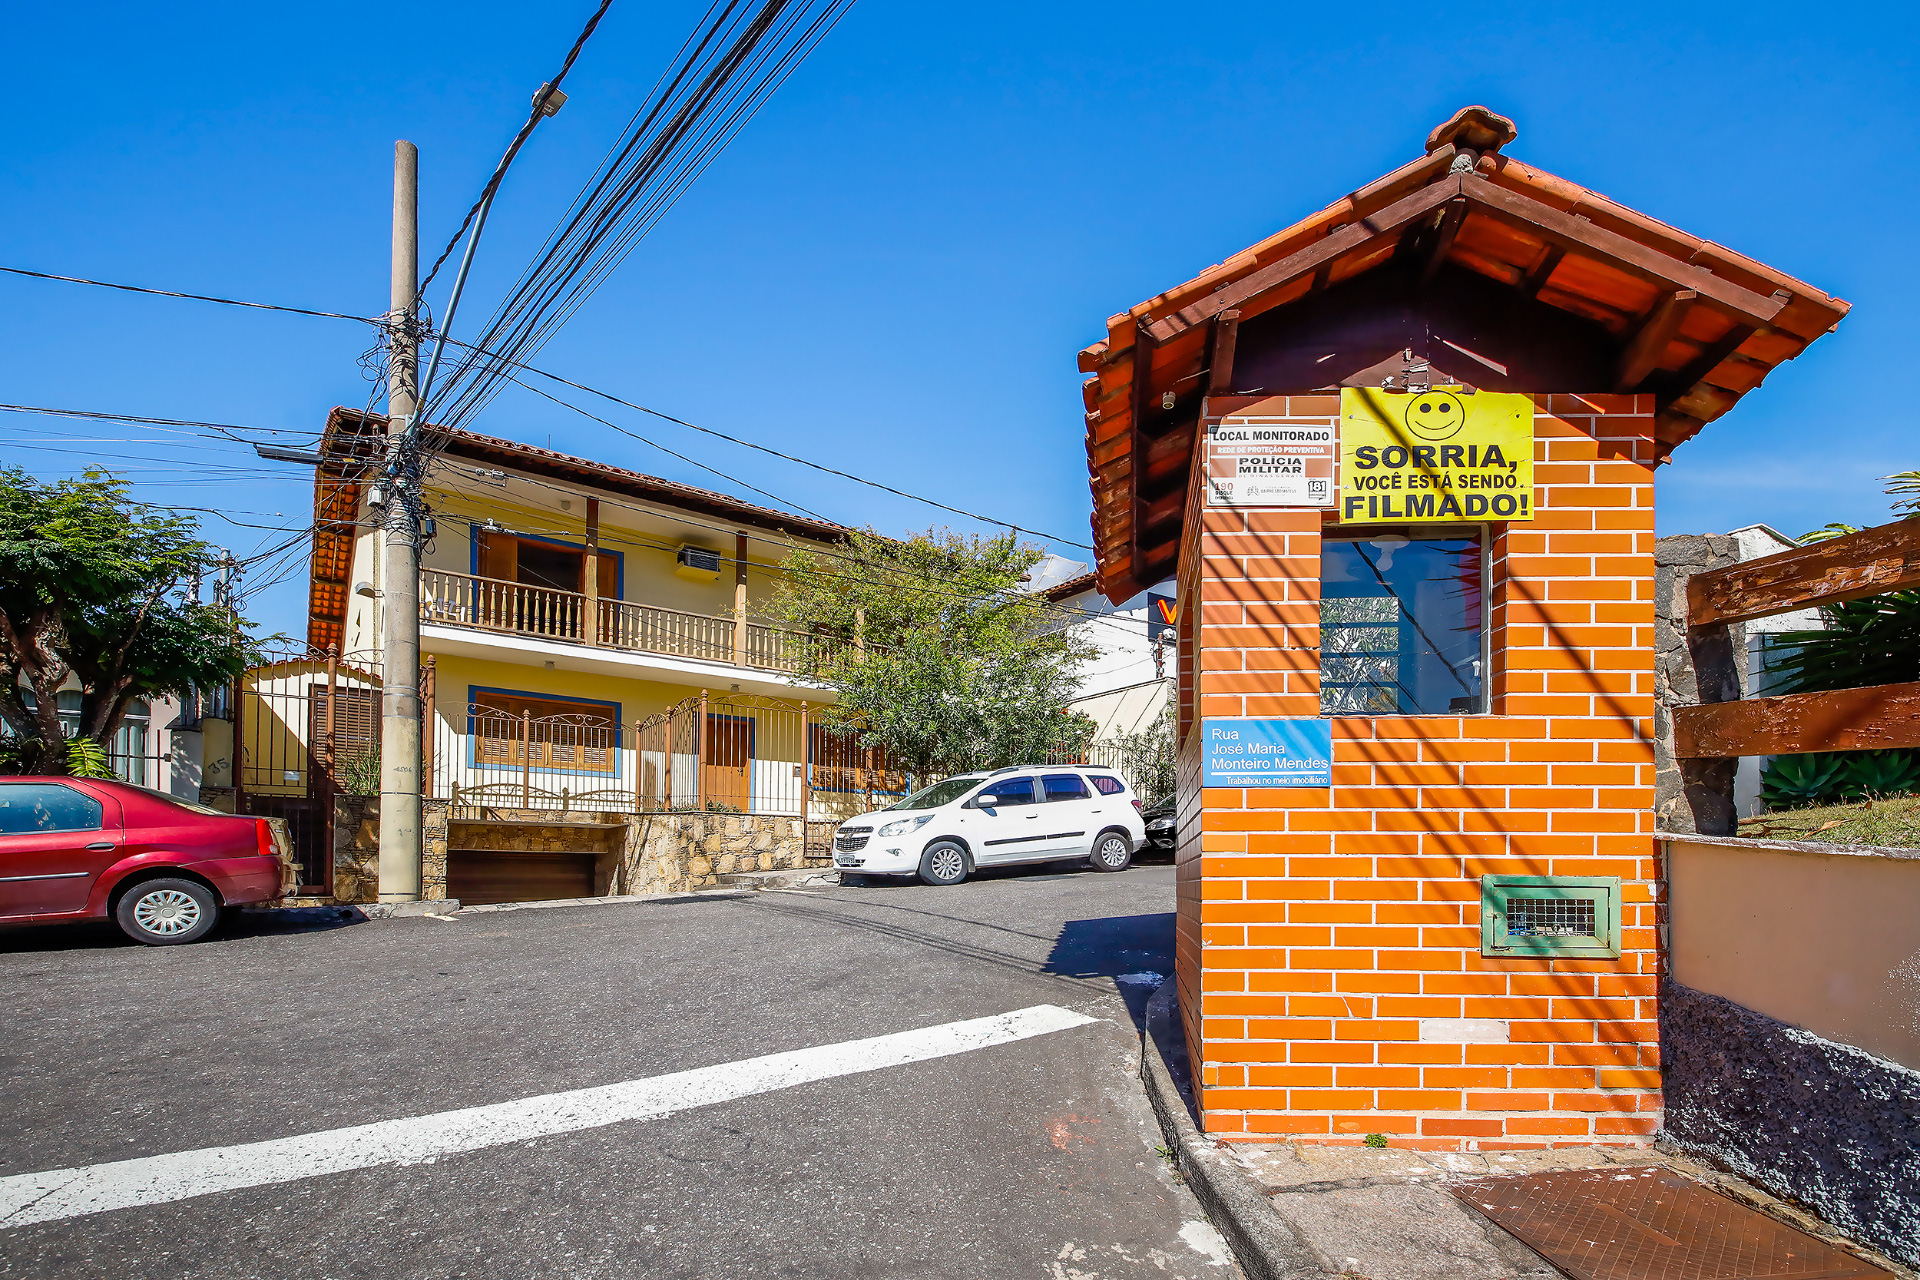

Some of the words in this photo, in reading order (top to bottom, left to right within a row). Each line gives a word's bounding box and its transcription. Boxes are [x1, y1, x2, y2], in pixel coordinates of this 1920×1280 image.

[1213, 431, 1250, 441] LOCAL
[1252, 431, 1330, 441] MONITORADO
[1217, 446, 1236, 454] REDE
[1237, 446, 1247, 454] DE
[1247, 444, 1283, 455] PROTEÇÃO
[1283, 446, 1325, 454] PREVENTIVA
[1238, 456, 1302, 465] POLÍCIA
[1354, 444, 1518, 473] SORRIA,
[1238, 466, 1302, 474] MILITAR
[1214, 482, 1234, 490] 190
[1307, 480, 1327, 492] 181
[1353, 471, 1402, 490] VOCÊ
[1408, 471, 1452, 489] ESTÁ
[1458, 474, 1517, 489] SENDO
[1344, 494, 1528, 519] FILMADO!
[1211, 728, 1240, 740] Rua
[1211, 742, 1244, 755] José
[1247, 742, 1286, 754] Maria
[207, 757, 230, 775] 35
[1211, 757, 1271, 770] Monteiro
[1274, 757, 1329, 769] Mendes
[1226, 776, 1261, 785] Trabalhou
[1291, 775, 1328, 784] imobiliário
